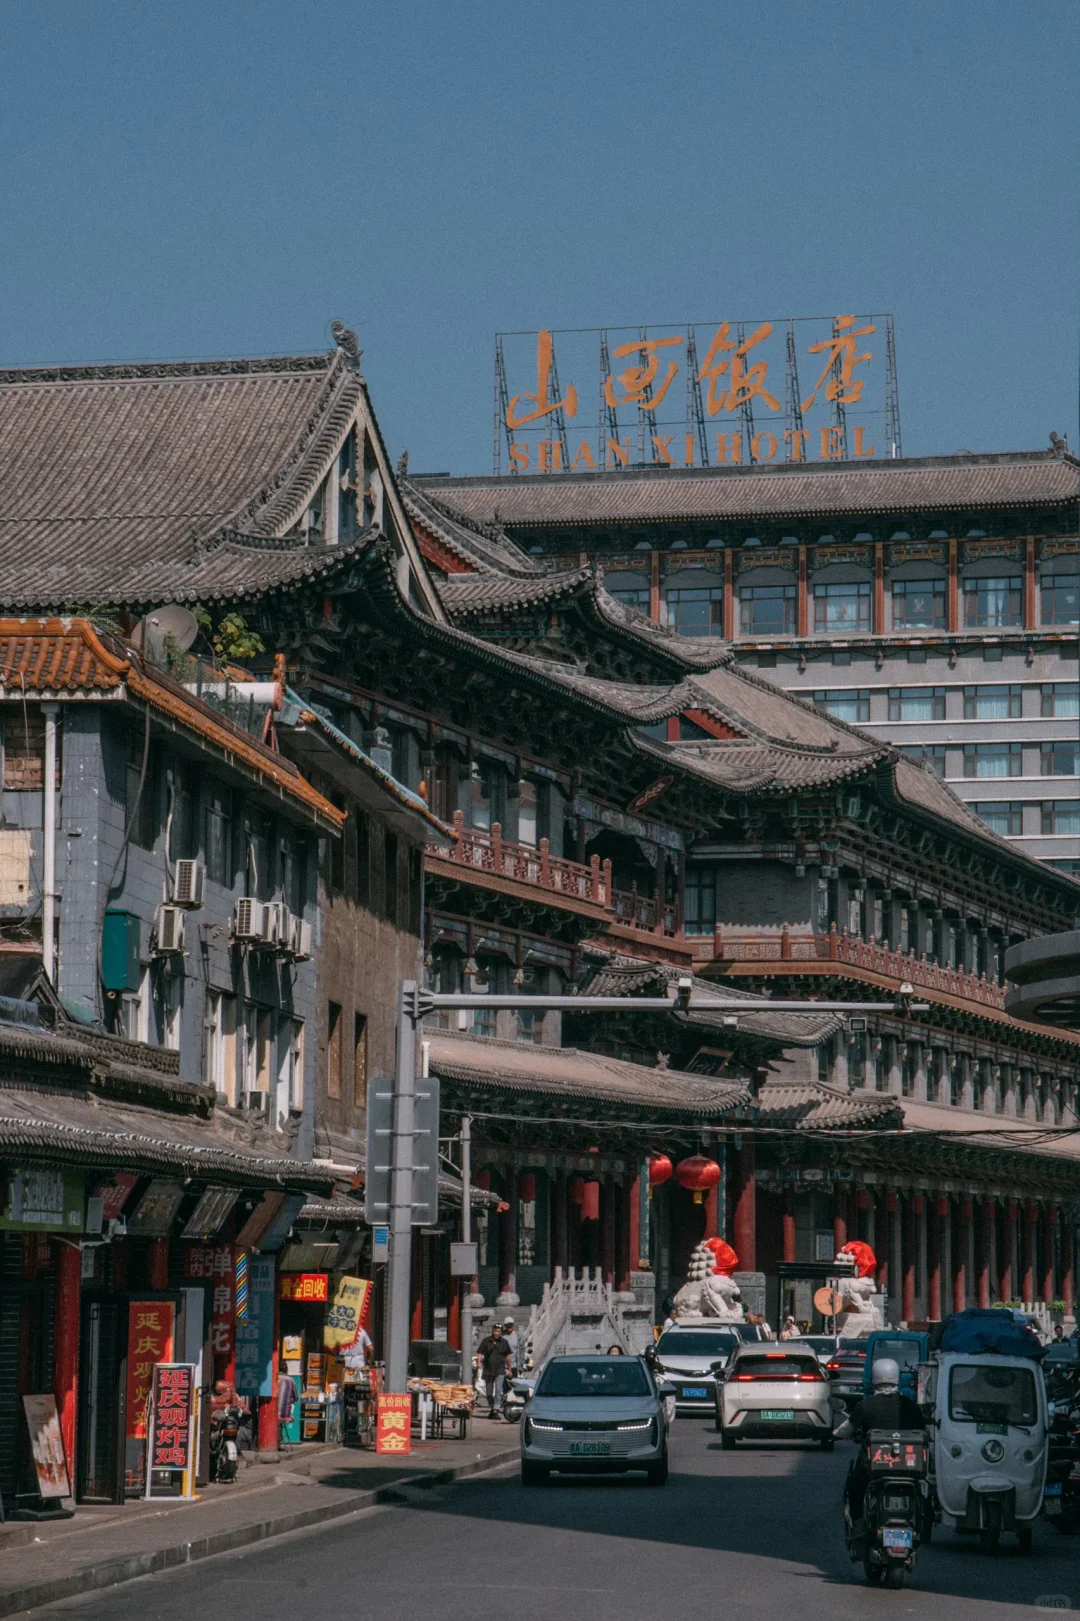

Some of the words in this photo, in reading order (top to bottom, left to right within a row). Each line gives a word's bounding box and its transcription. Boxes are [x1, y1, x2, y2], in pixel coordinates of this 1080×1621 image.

[505, 315, 877, 430] 山西饭店
[715, 426, 875, 463] HOTEL
[280, 1277, 326, 1299] 黄金回收
[155, 1369, 190, 1467] 延庆观炸鸡
[378, 1396, 411, 1408] 高价回收
[380, 1411, 409, 1451] 黄金
